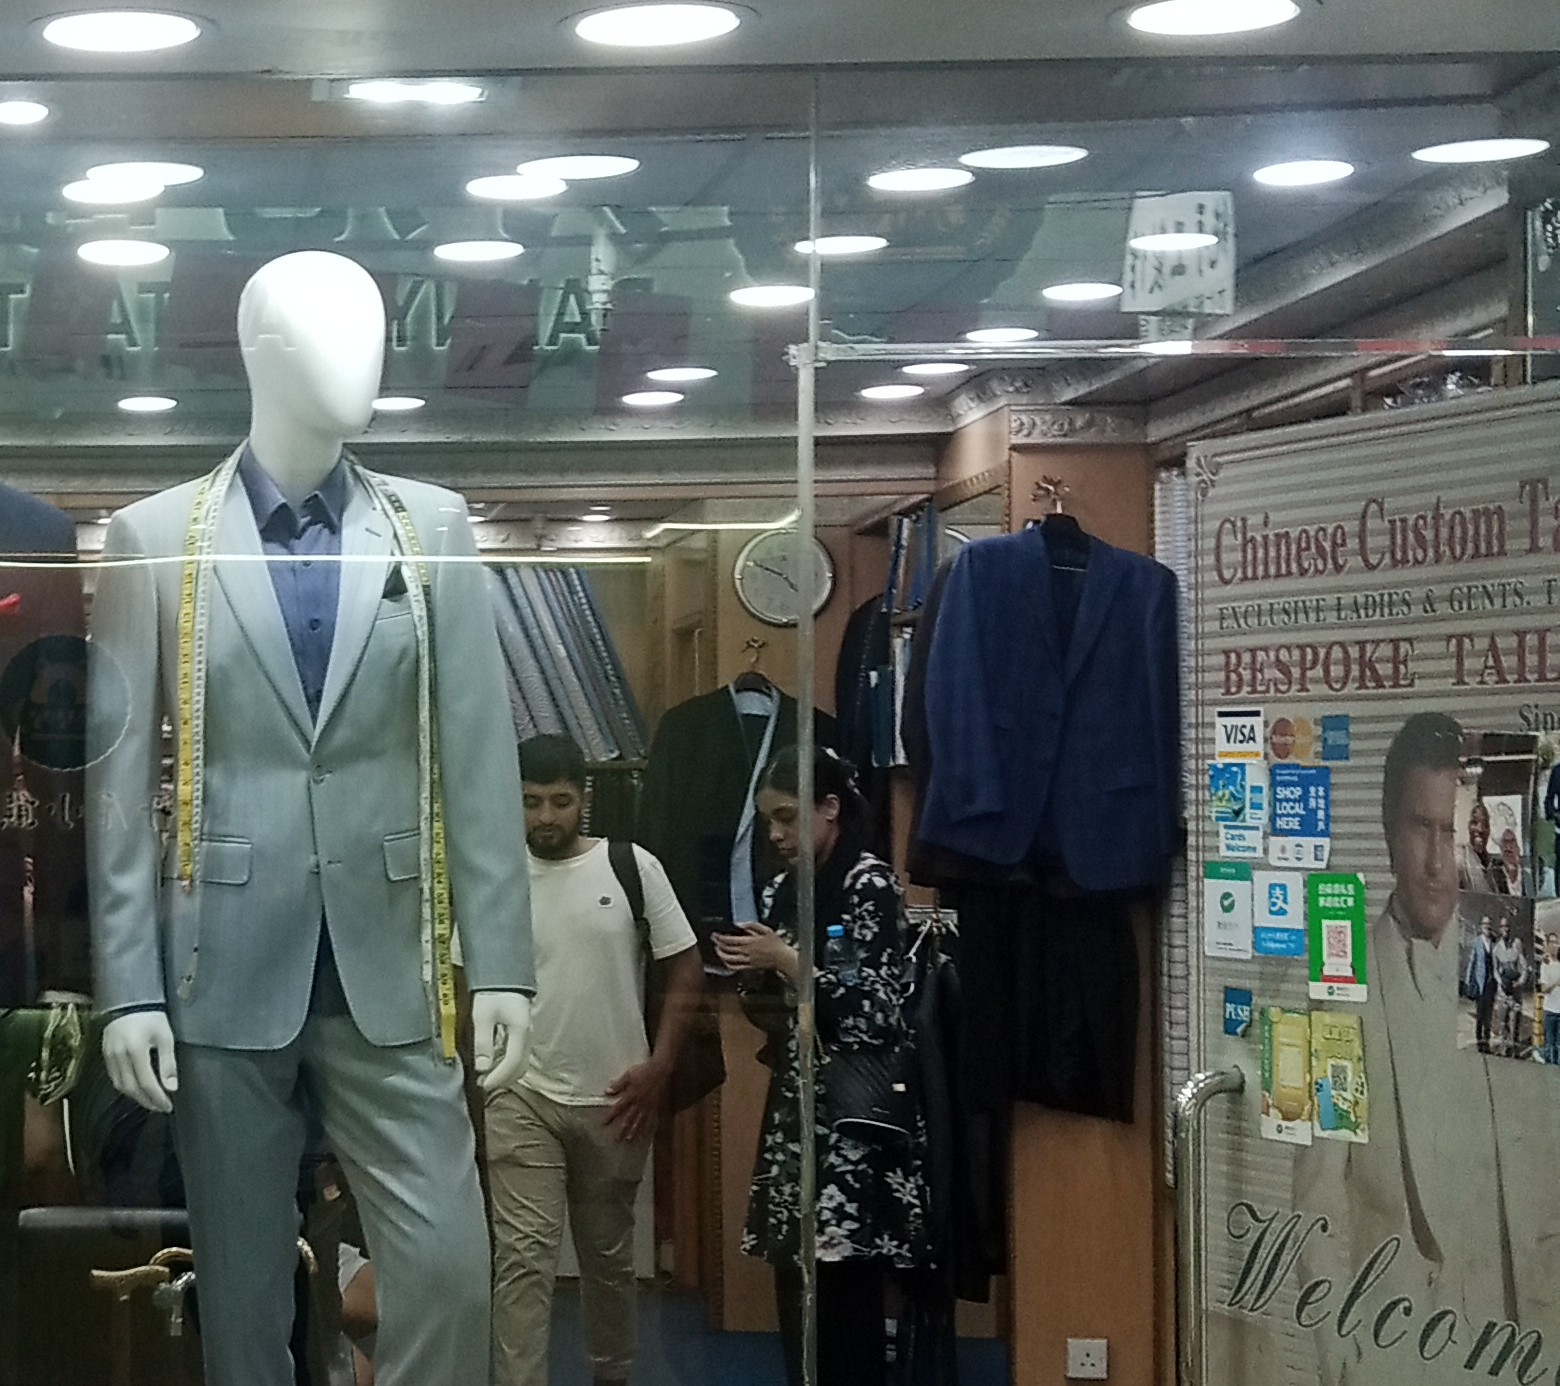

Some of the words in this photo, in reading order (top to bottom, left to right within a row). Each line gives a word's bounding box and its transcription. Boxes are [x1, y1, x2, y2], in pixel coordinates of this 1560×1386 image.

[1214, 511, 1349, 586] Chinese
[1358, 495, 1510, 571] Custom
[1518, 478, 1560, 556] T
[1218, 597, 1327, 631] EXCLUSIVE
[1336, 589, 1413, 623] LADIES
[1423, 588, 1438, 615] &
[1449, 579, 1532, 614] GENTS.
[1221, 636, 1420, 698] BESPOKE
[1518, 701, 1560, 733] Sin
[1222, 723, 1257, 745] VISA
[1275, 786, 1303, 799] SHOP
[1275, 801, 1307, 815] LOCAL
[1275, 816, 1302, 830] HERE
